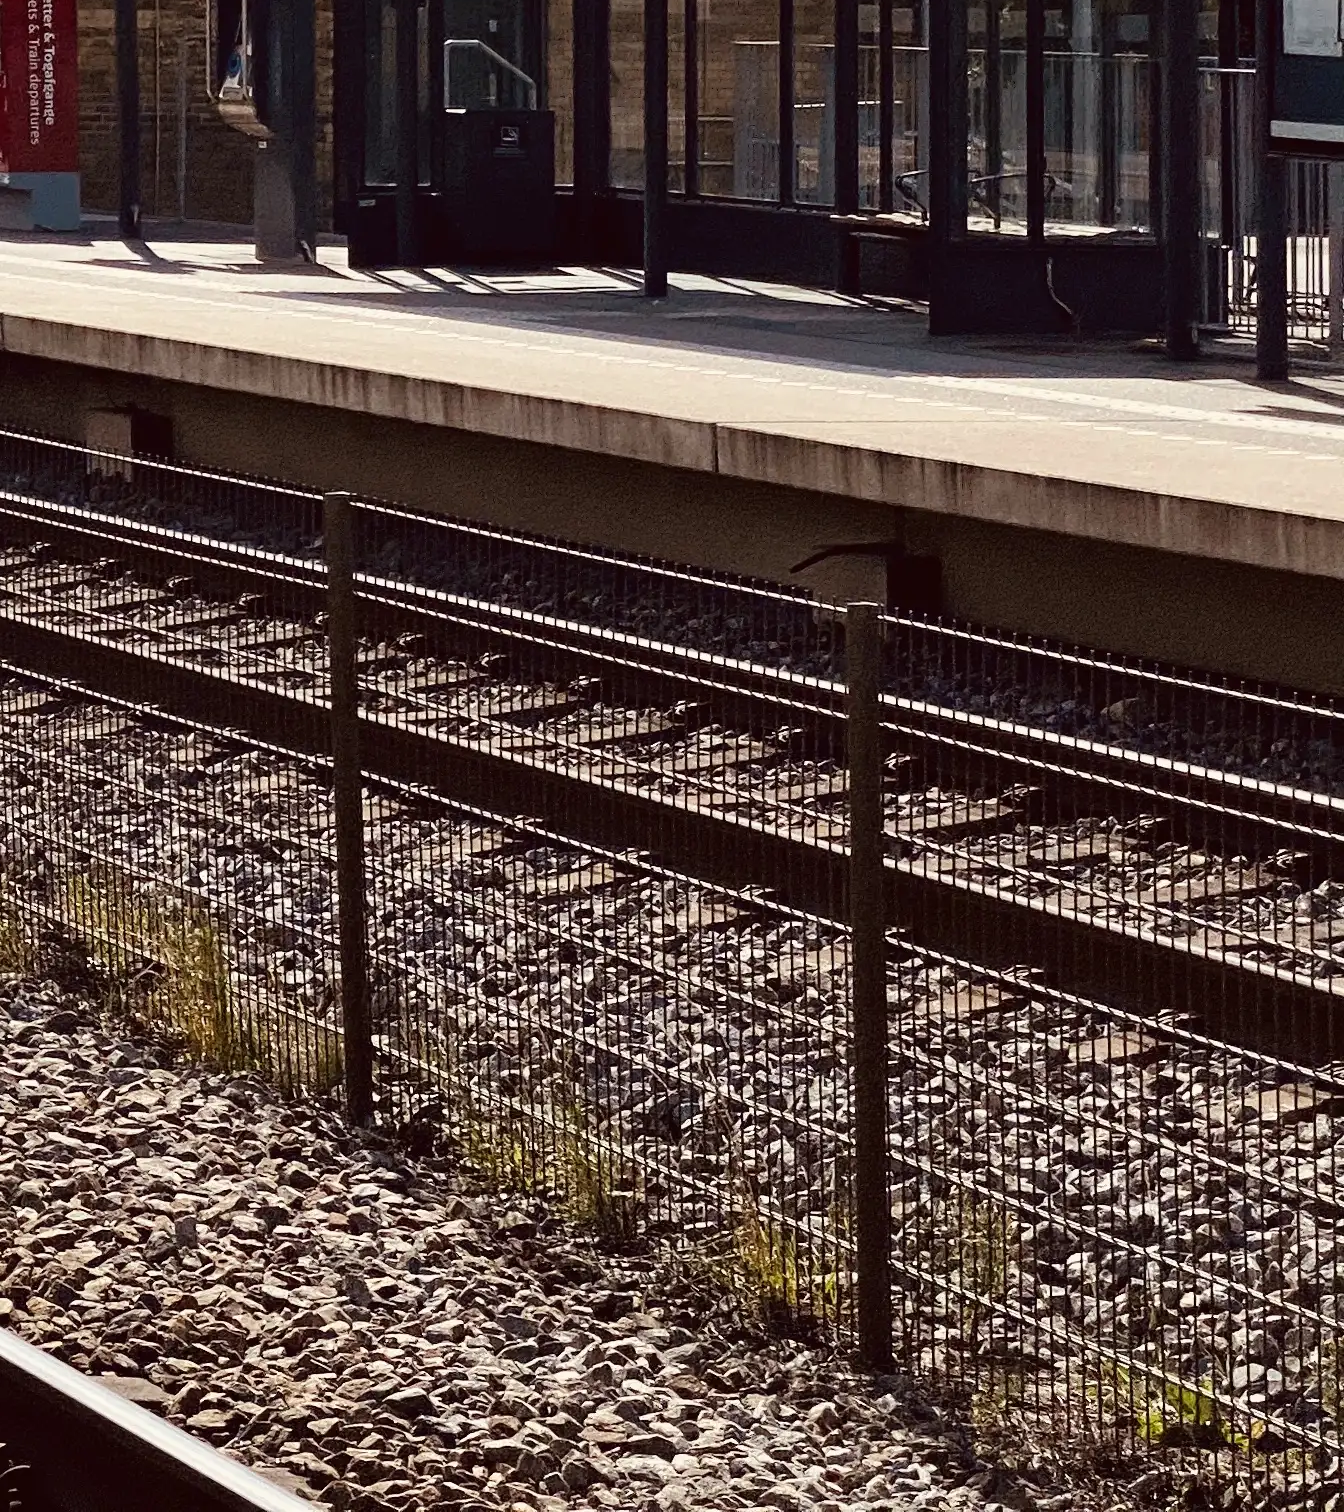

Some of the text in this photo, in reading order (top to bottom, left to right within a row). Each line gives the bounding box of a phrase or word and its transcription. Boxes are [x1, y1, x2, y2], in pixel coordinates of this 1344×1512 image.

[28, 23, 40, 34] &
[43, 32, 55, 43] &
[28, 38, 41, 70] Train
[42, 45, 56, 126] Togafgange
[26, 73, 41, 145] departures
